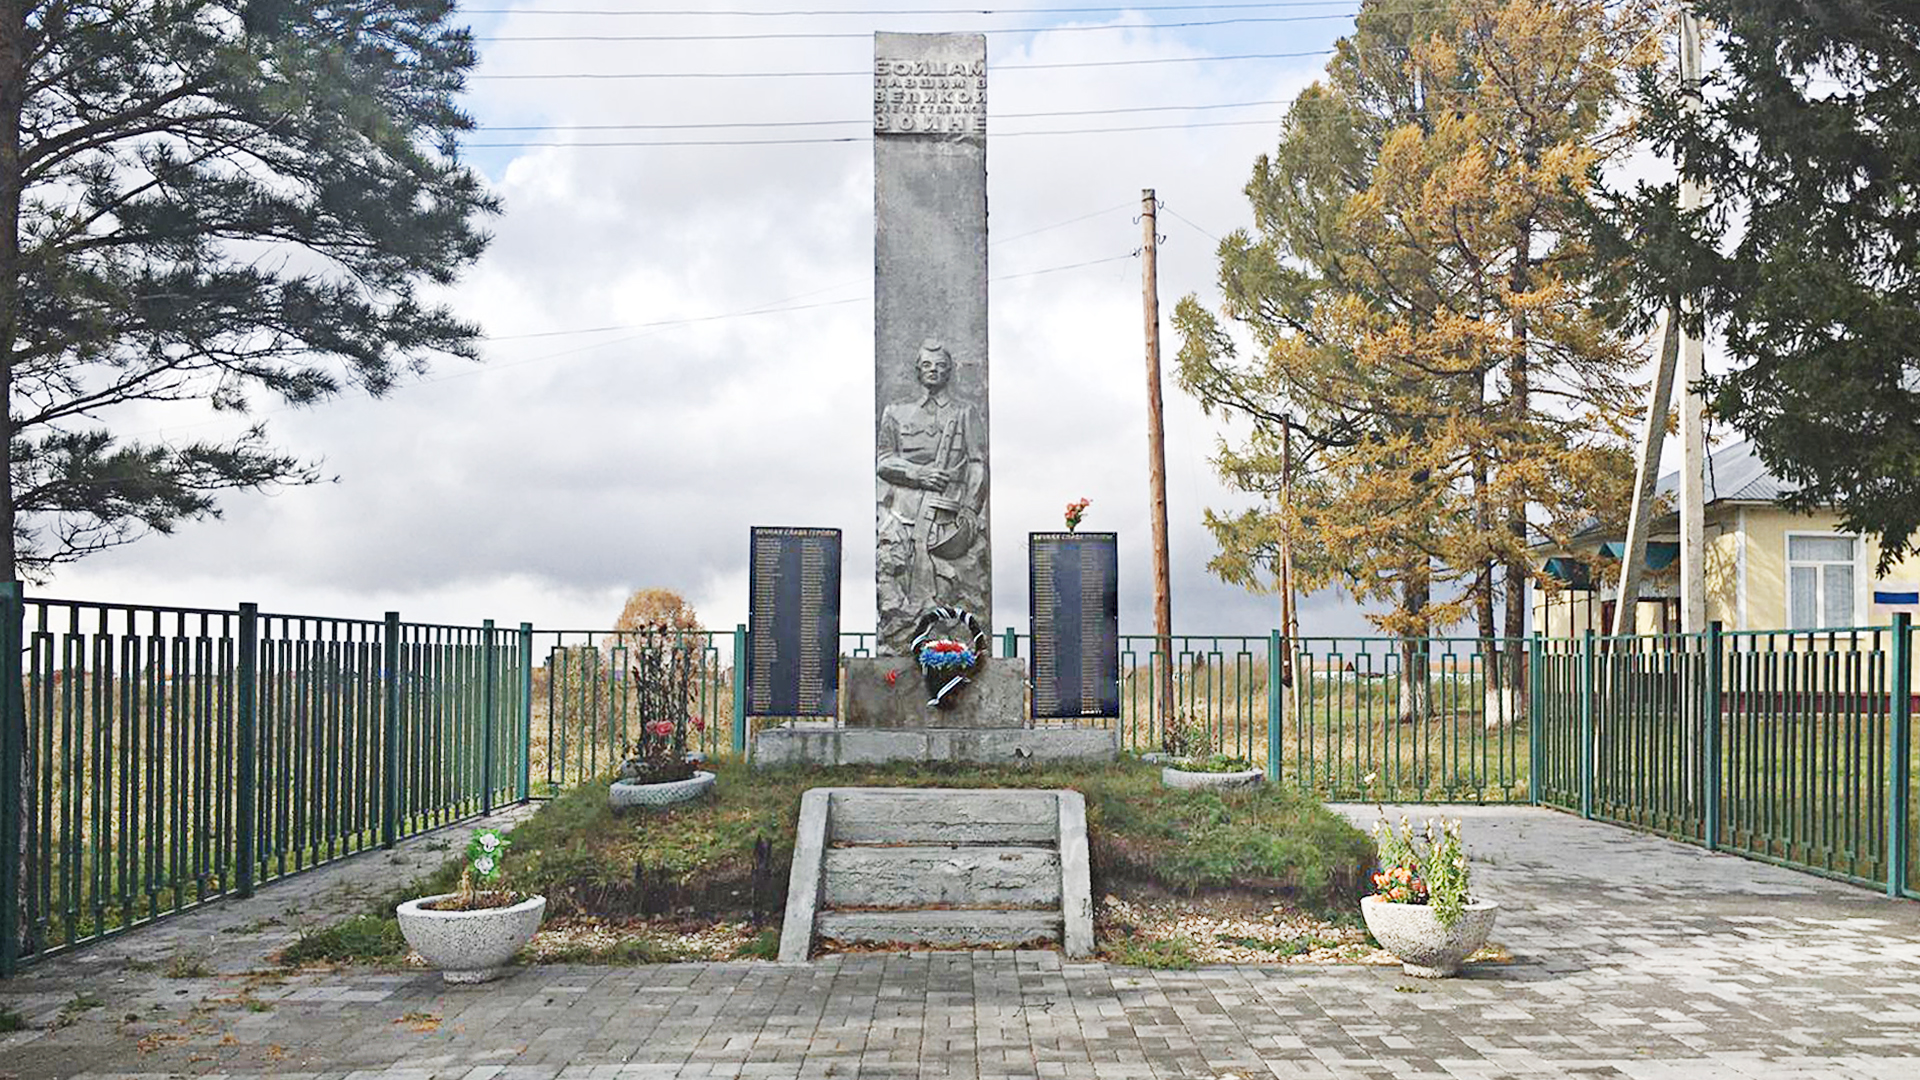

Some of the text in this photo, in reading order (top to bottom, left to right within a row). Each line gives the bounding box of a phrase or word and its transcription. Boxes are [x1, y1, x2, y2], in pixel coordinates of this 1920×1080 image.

[874, 78, 987, 90] ПАВШИМ В
[874, 91, 987, 104] ВЕЛИКОЙ
[874, 116, 987, 131] ВОЙНЕ
